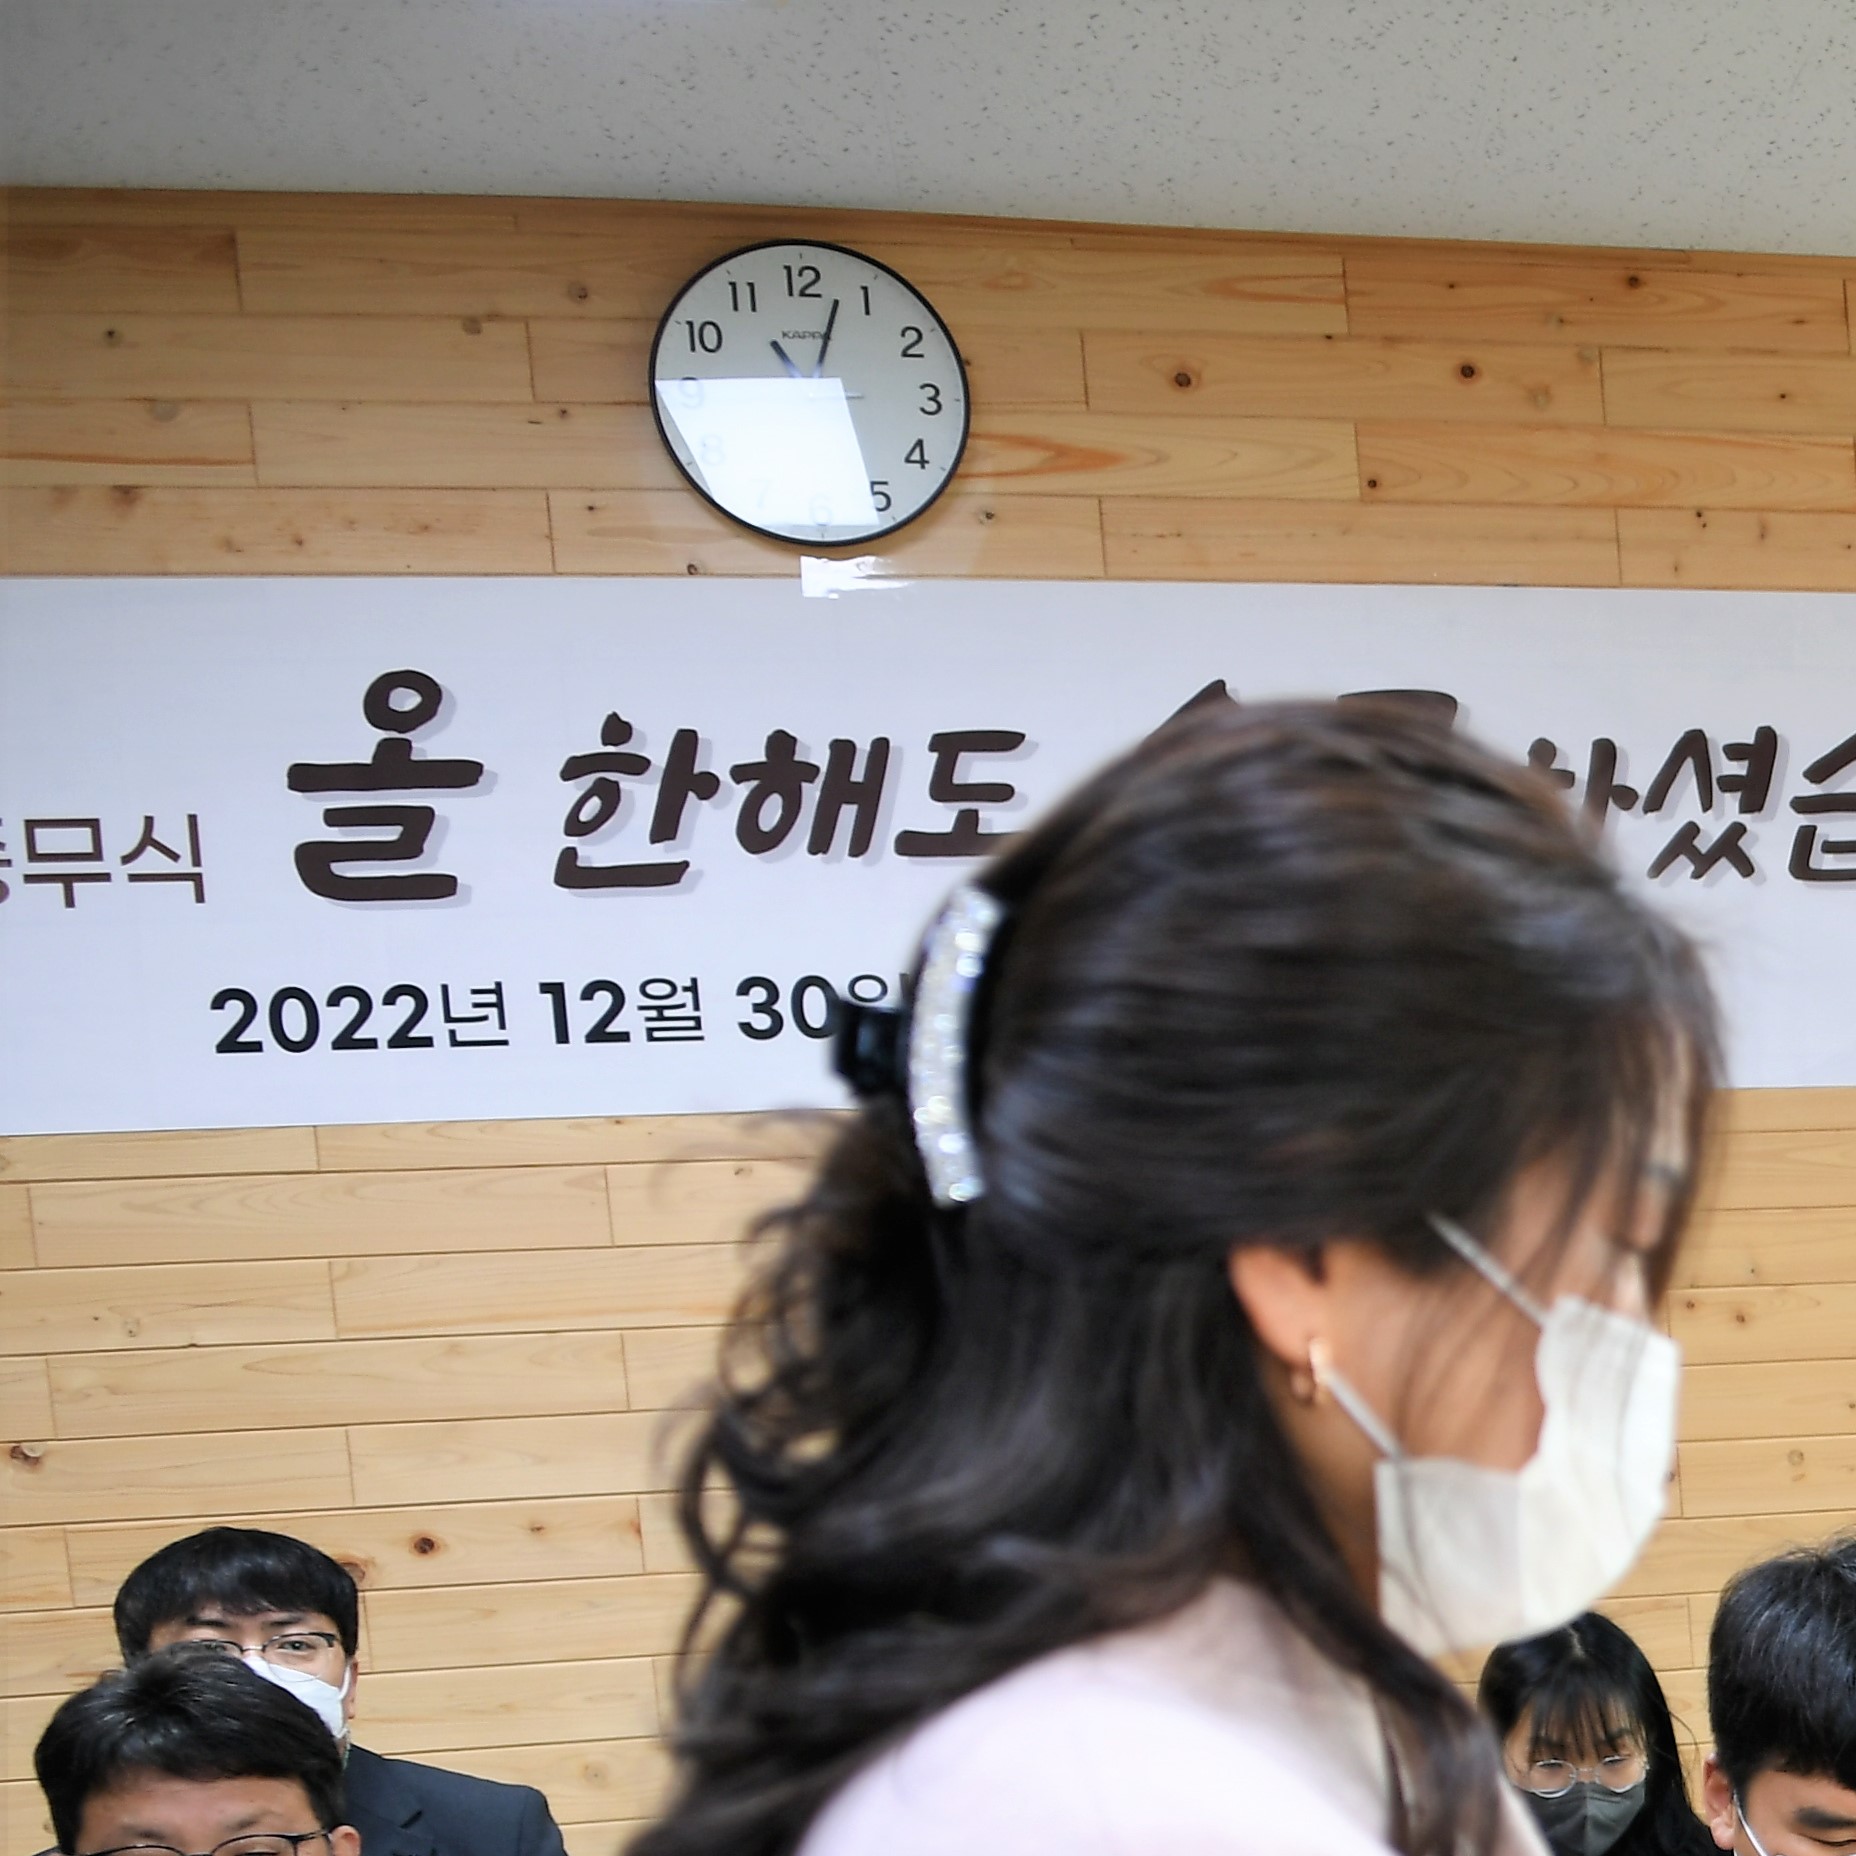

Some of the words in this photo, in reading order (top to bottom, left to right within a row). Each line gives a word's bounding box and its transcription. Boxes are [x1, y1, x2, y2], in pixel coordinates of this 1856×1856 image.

[728, 281, 757, 312] 11
[783, 265, 823, 298] 12
[860, 285, 871, 316] 1
[685, 320, 723, 353] 10
[900, 326, 925, 358] 2
[918, 383, 943, 415] 3
[904, 438, 930, 470] 4
[870, 481, 892, 512] 5
[287, 669, 484, 901] 올
[554, 711, 1026, 889] 한해도
[210, 981, 509, 1054] 2022년
[538, 976, 705, 1045] 12월
